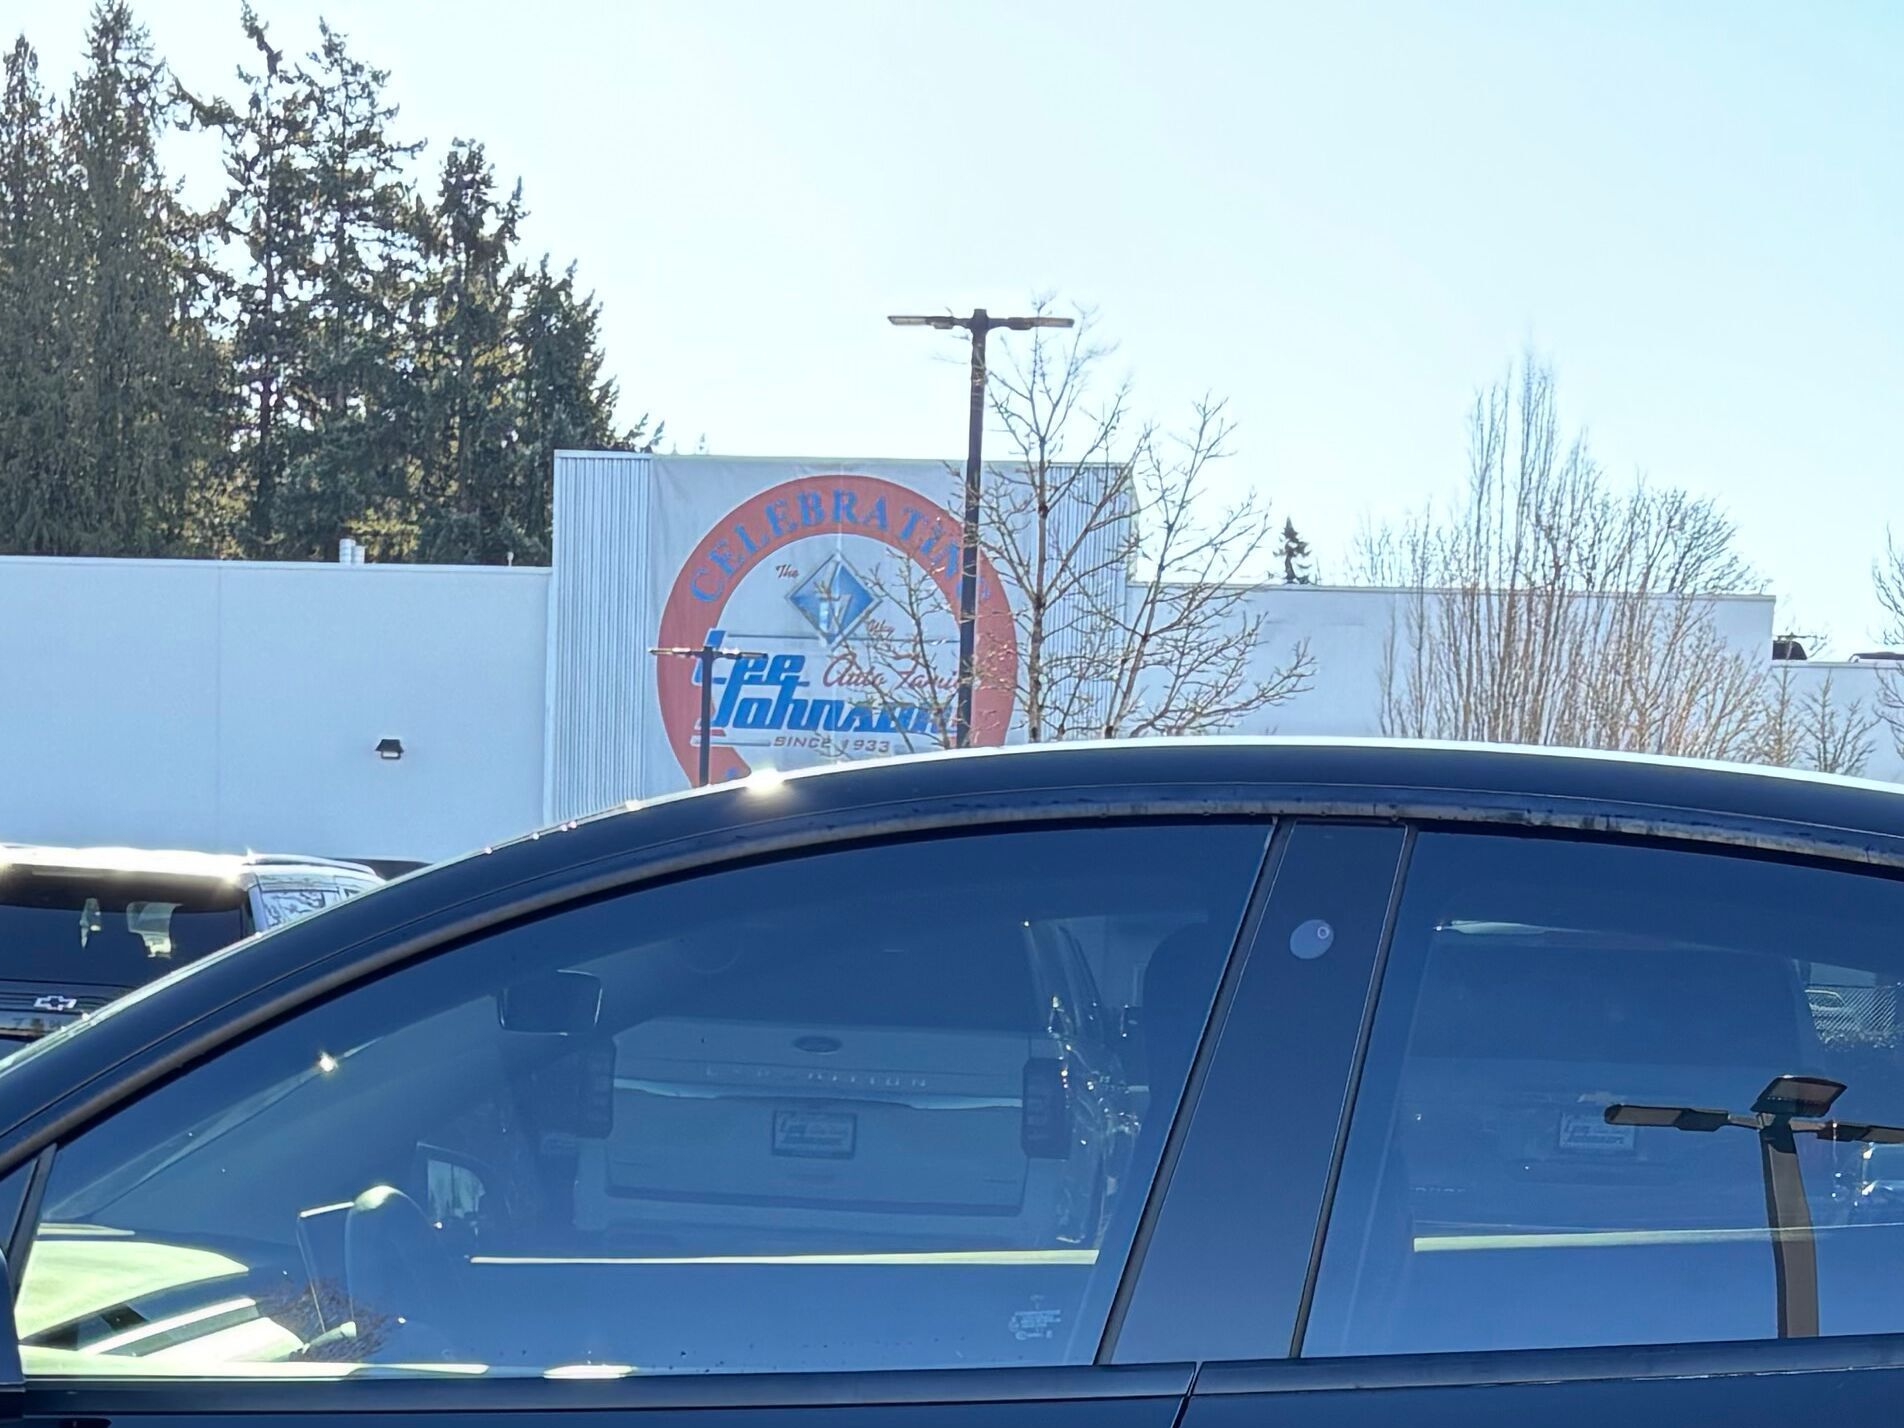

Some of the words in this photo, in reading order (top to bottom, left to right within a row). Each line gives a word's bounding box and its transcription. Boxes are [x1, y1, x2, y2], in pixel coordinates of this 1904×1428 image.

[689, 488, 990, 603] CELEBRATIN
[693, 629, 806, 686] Lee
[773, 735, 832, 750] SINCE
[843, 739, 891, 753] 1933
